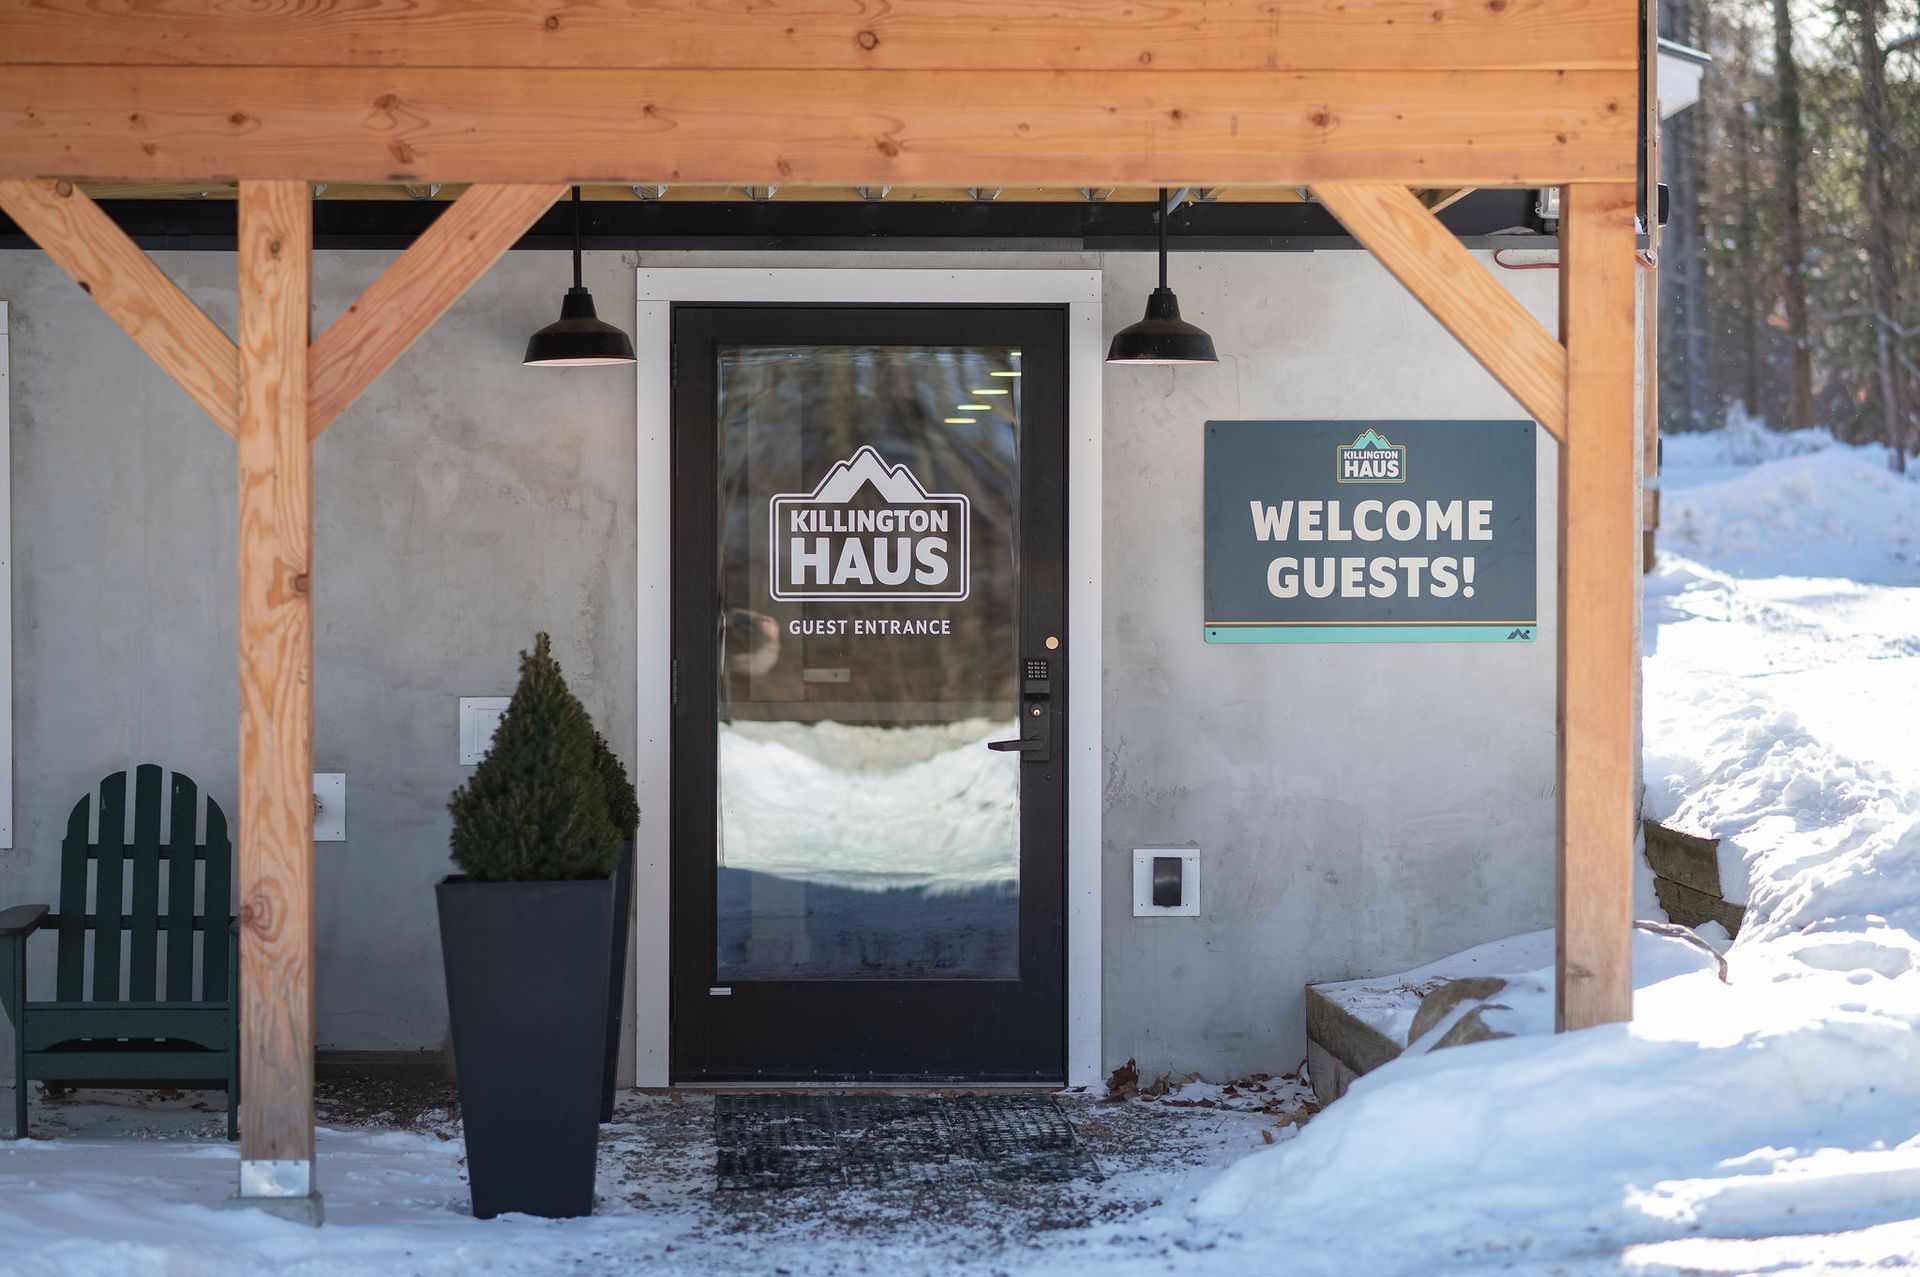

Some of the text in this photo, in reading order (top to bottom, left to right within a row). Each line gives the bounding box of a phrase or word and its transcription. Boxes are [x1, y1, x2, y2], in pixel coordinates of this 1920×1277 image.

[1343, 450, 1398, 460] KILLINGTON
[1344, 460, 1399, 477] HAUS
[790, 509, 949, 532] KILLINGTON
[1249, 500, 1493, 541] WELCOME
[790, 536, 949, 586] HAUS
[1267, 556, 1476, 598] GUESTS!
[789, 620, 951, 635] GUEST ENTRANCE
